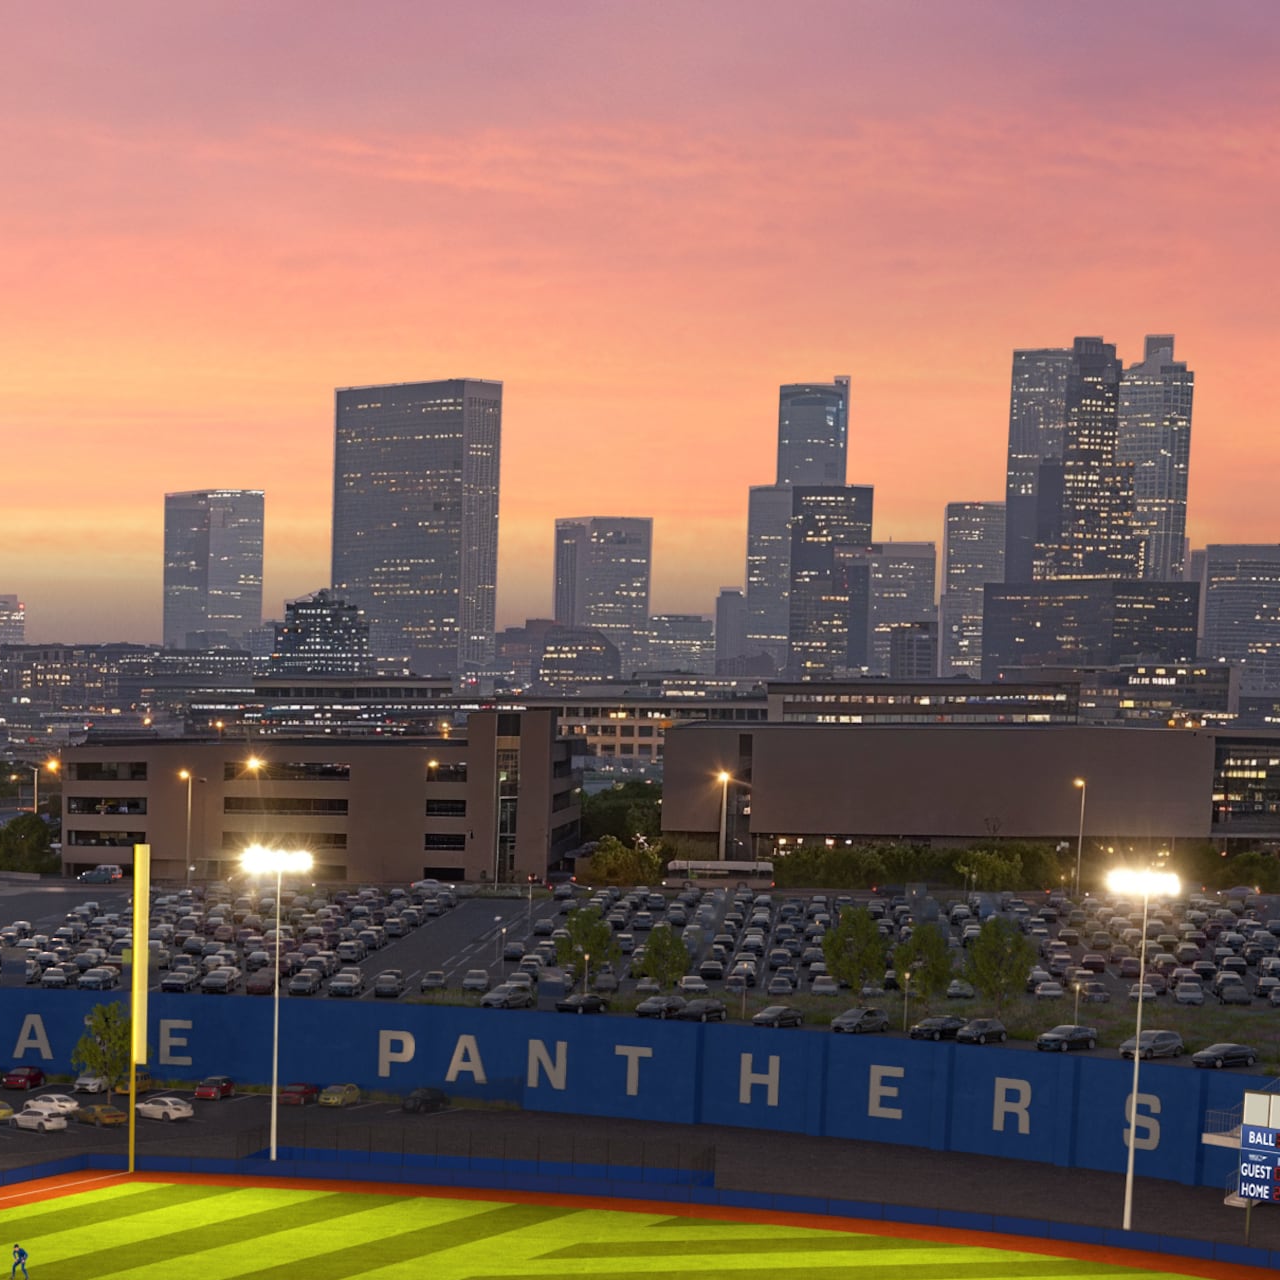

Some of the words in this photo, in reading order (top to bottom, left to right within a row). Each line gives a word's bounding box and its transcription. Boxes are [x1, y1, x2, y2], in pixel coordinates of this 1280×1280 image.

[377, 1029, 1162, 1152] PANTHERS
[1248, 1131, 1275, 1147] BALL
[1240, 1162, 1272, 1179] GUEST
[1241, 1182, 1269, 1199] HOME
